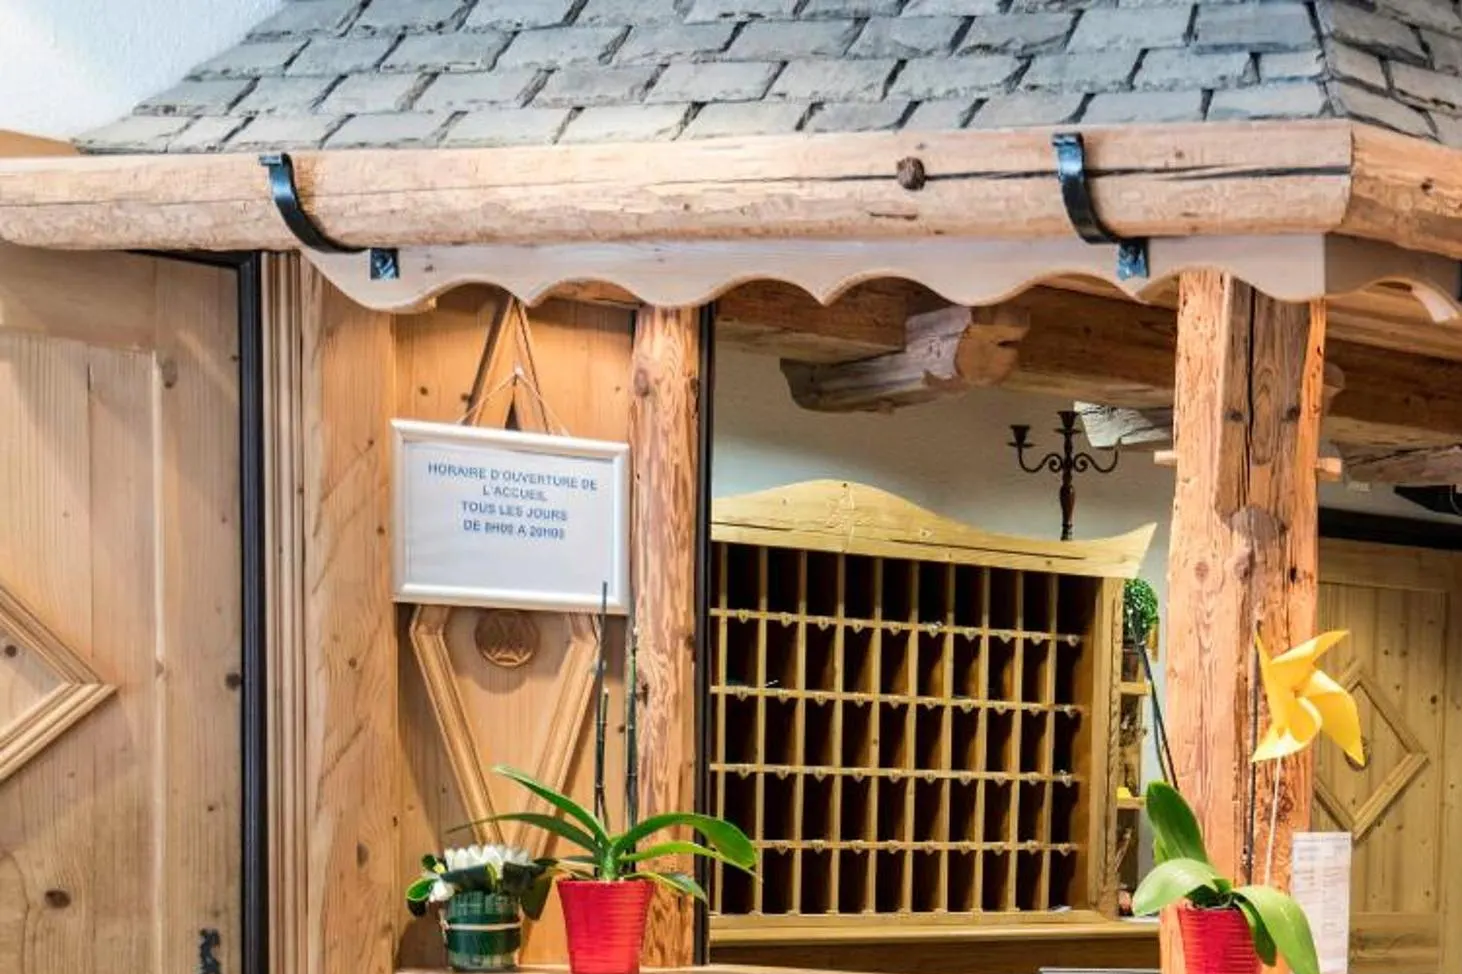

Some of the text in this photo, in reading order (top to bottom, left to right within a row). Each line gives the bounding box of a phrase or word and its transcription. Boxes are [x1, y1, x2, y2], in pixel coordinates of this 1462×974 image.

[428, 462, 486, 479] HORAIRE
[581, 477, 598, 491] DE
[463, 501, 567, 521] TOUS LES JOURS
[463, 519, 481, 531] DE
